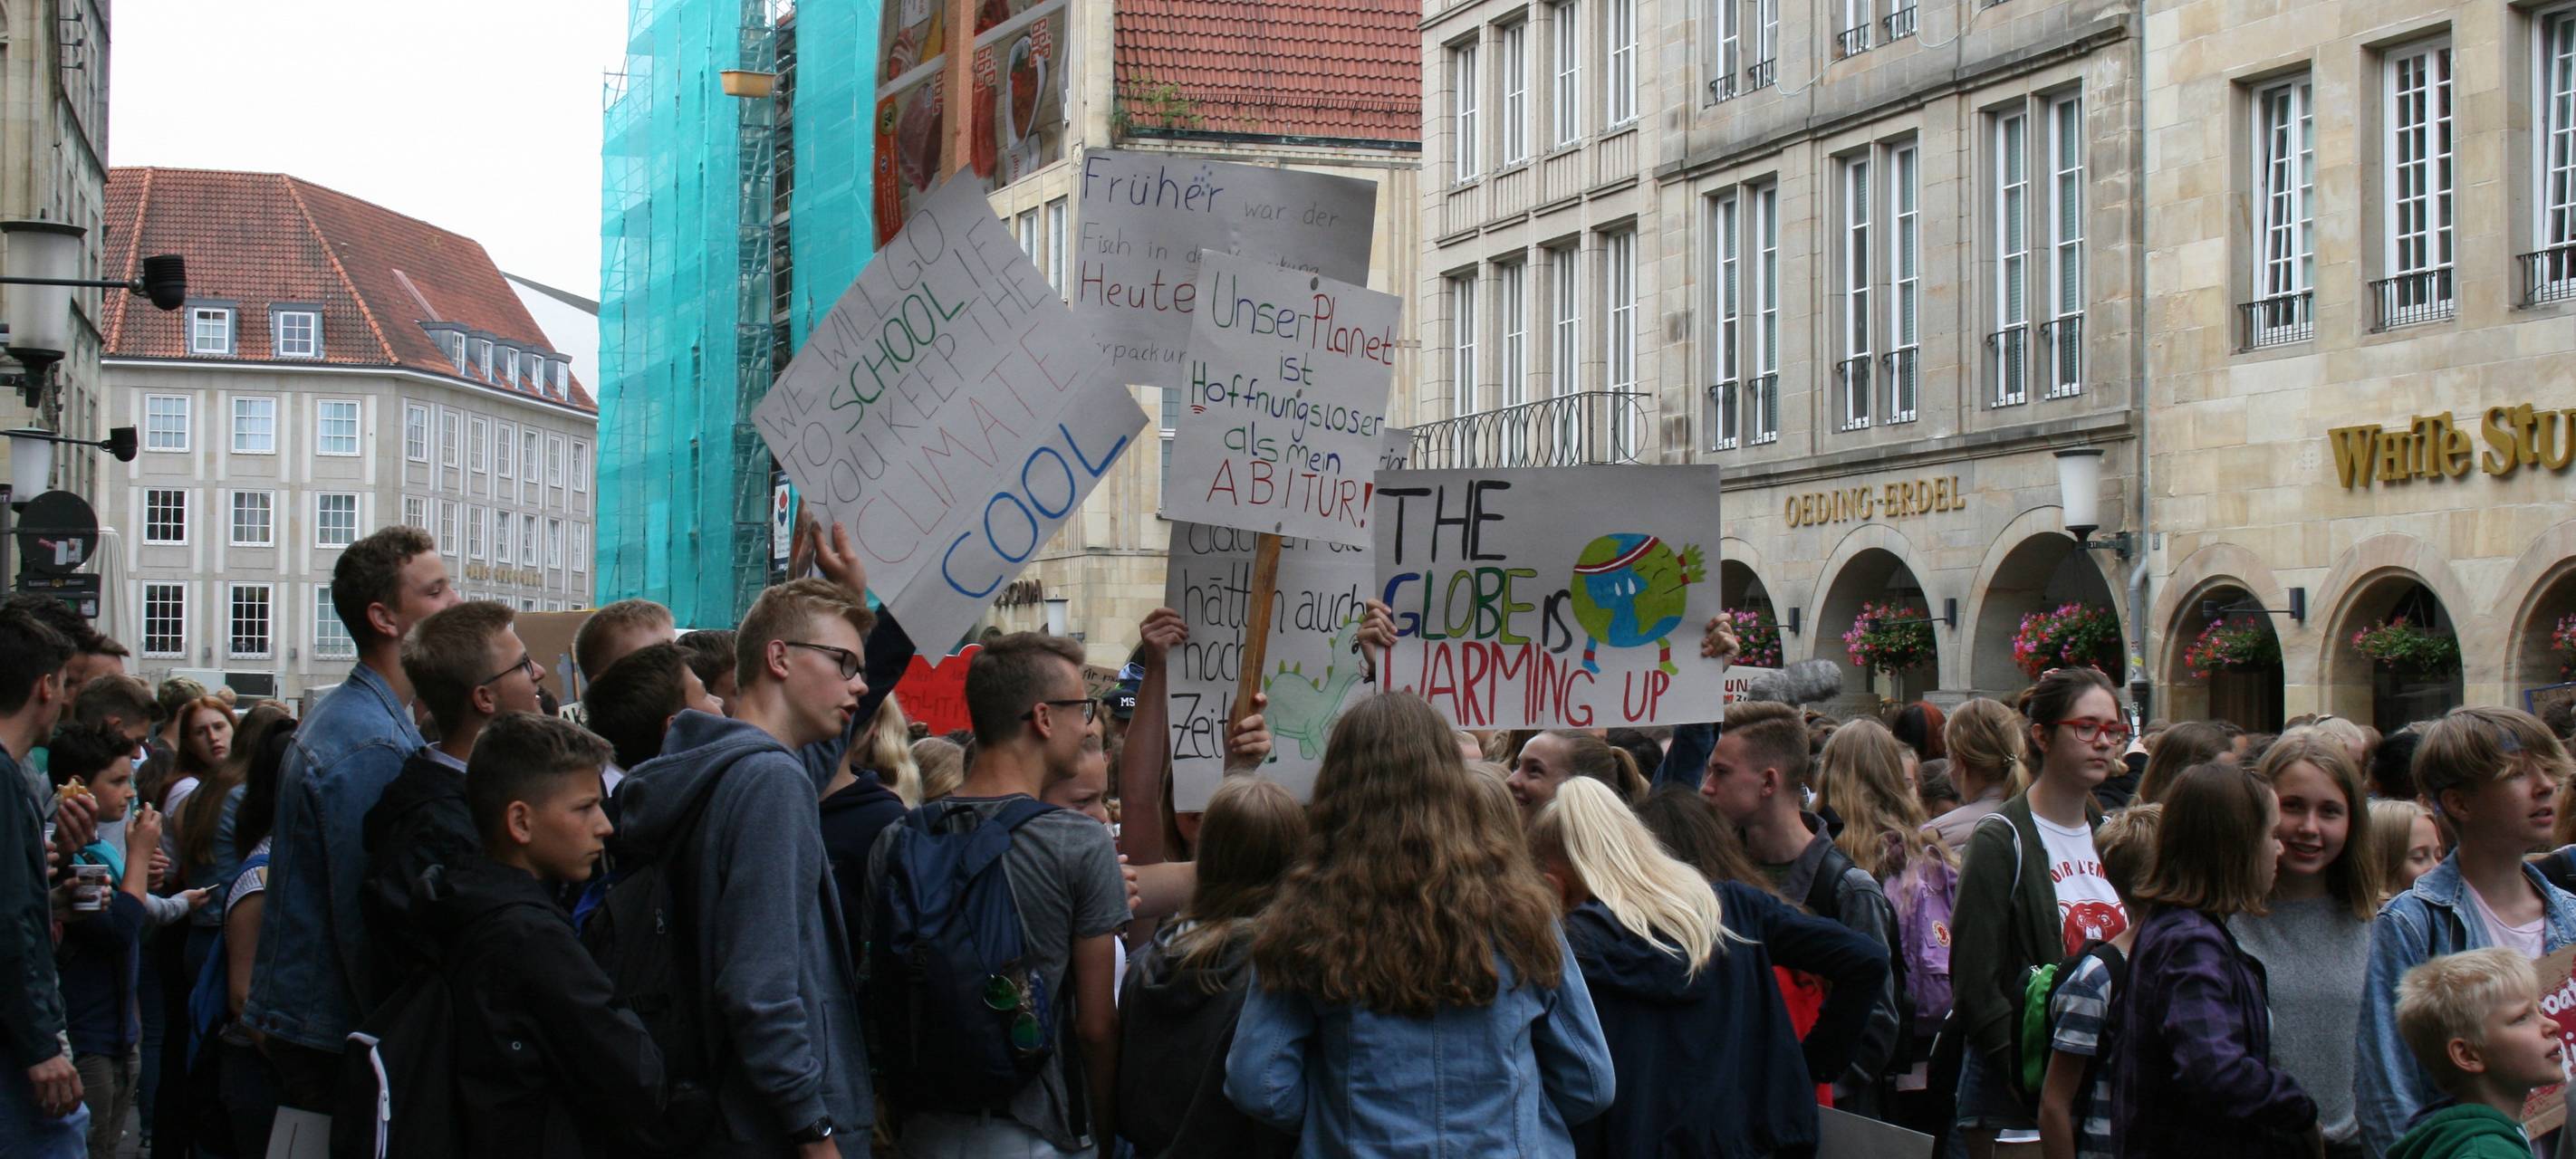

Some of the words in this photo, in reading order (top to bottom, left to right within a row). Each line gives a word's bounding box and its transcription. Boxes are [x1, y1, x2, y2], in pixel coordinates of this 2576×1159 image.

[1082, 156, 1225, 214] Früher
[1244, 201, 1287, 220] war
[1302, 201, 1340, 227] der
[1081, 222, 1131, 254] Fisch
[1148, 240, 1168, 263] in
[1079, 260, 1196, 313] Heute
[1211, 271, 1311, 341] Unser
[1311, 294, 1393, 366] Planet
[762, 365, 817, 439] WE
[812, 282, 899, 371] WILL
[885, 209, 945, 290] GO
[781, 421, 833, 485] TO
[830, 282, 966, 434] SCHOOL
[954, 216, 993, 288] IF
[810, 433, 891, 521] YOU
[878, 333, 965, 446] KEEP
[957, 256, 1048, 346] THE
[1189, 359, 1385, 442] Hoffnungsloser
[1279, 350, 1313, 386] ist
[856, 321, 1080, 565] CLIMATE
[1225, 420, 1279, 463] als
[941, 422, 1128, 599] COOL
[1206, 458, 1375, 529] ABITUR!
[1376, 479, 1512, 566] THE
[1784, 475, 1966, 528] OEDING-ERDEL
[1183, 561, 1284, 634] hättn
[1294, 584, 1367, 634] auch
[1382, 566, 1539, 646] GLOBE
[1170, 691, 1229, 761] Zeit
[1622, 669, 1671, 723] UP
